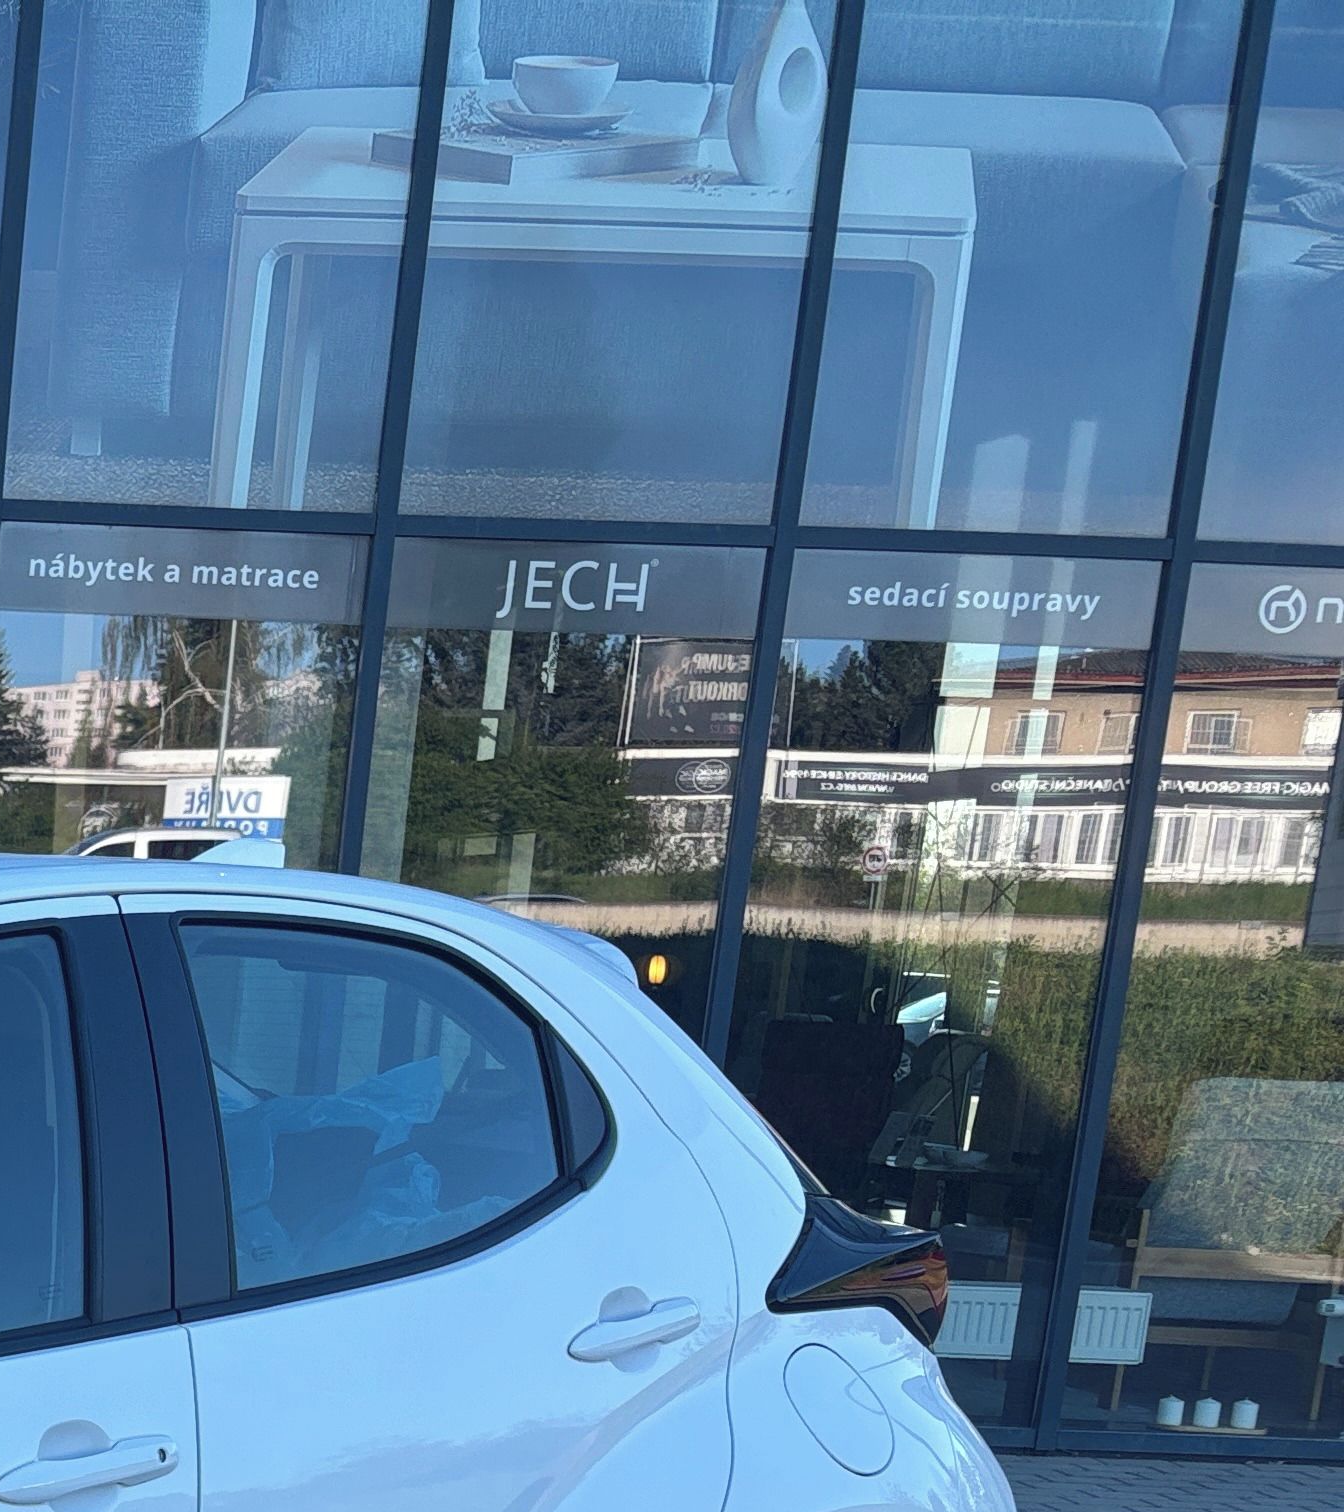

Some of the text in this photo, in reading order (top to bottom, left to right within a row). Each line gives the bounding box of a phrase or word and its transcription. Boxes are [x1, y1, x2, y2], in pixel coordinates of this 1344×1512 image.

[28, 553, 320, 589] nábytek a matrace
[847, 581, 1101, 620] sedací soupravy
